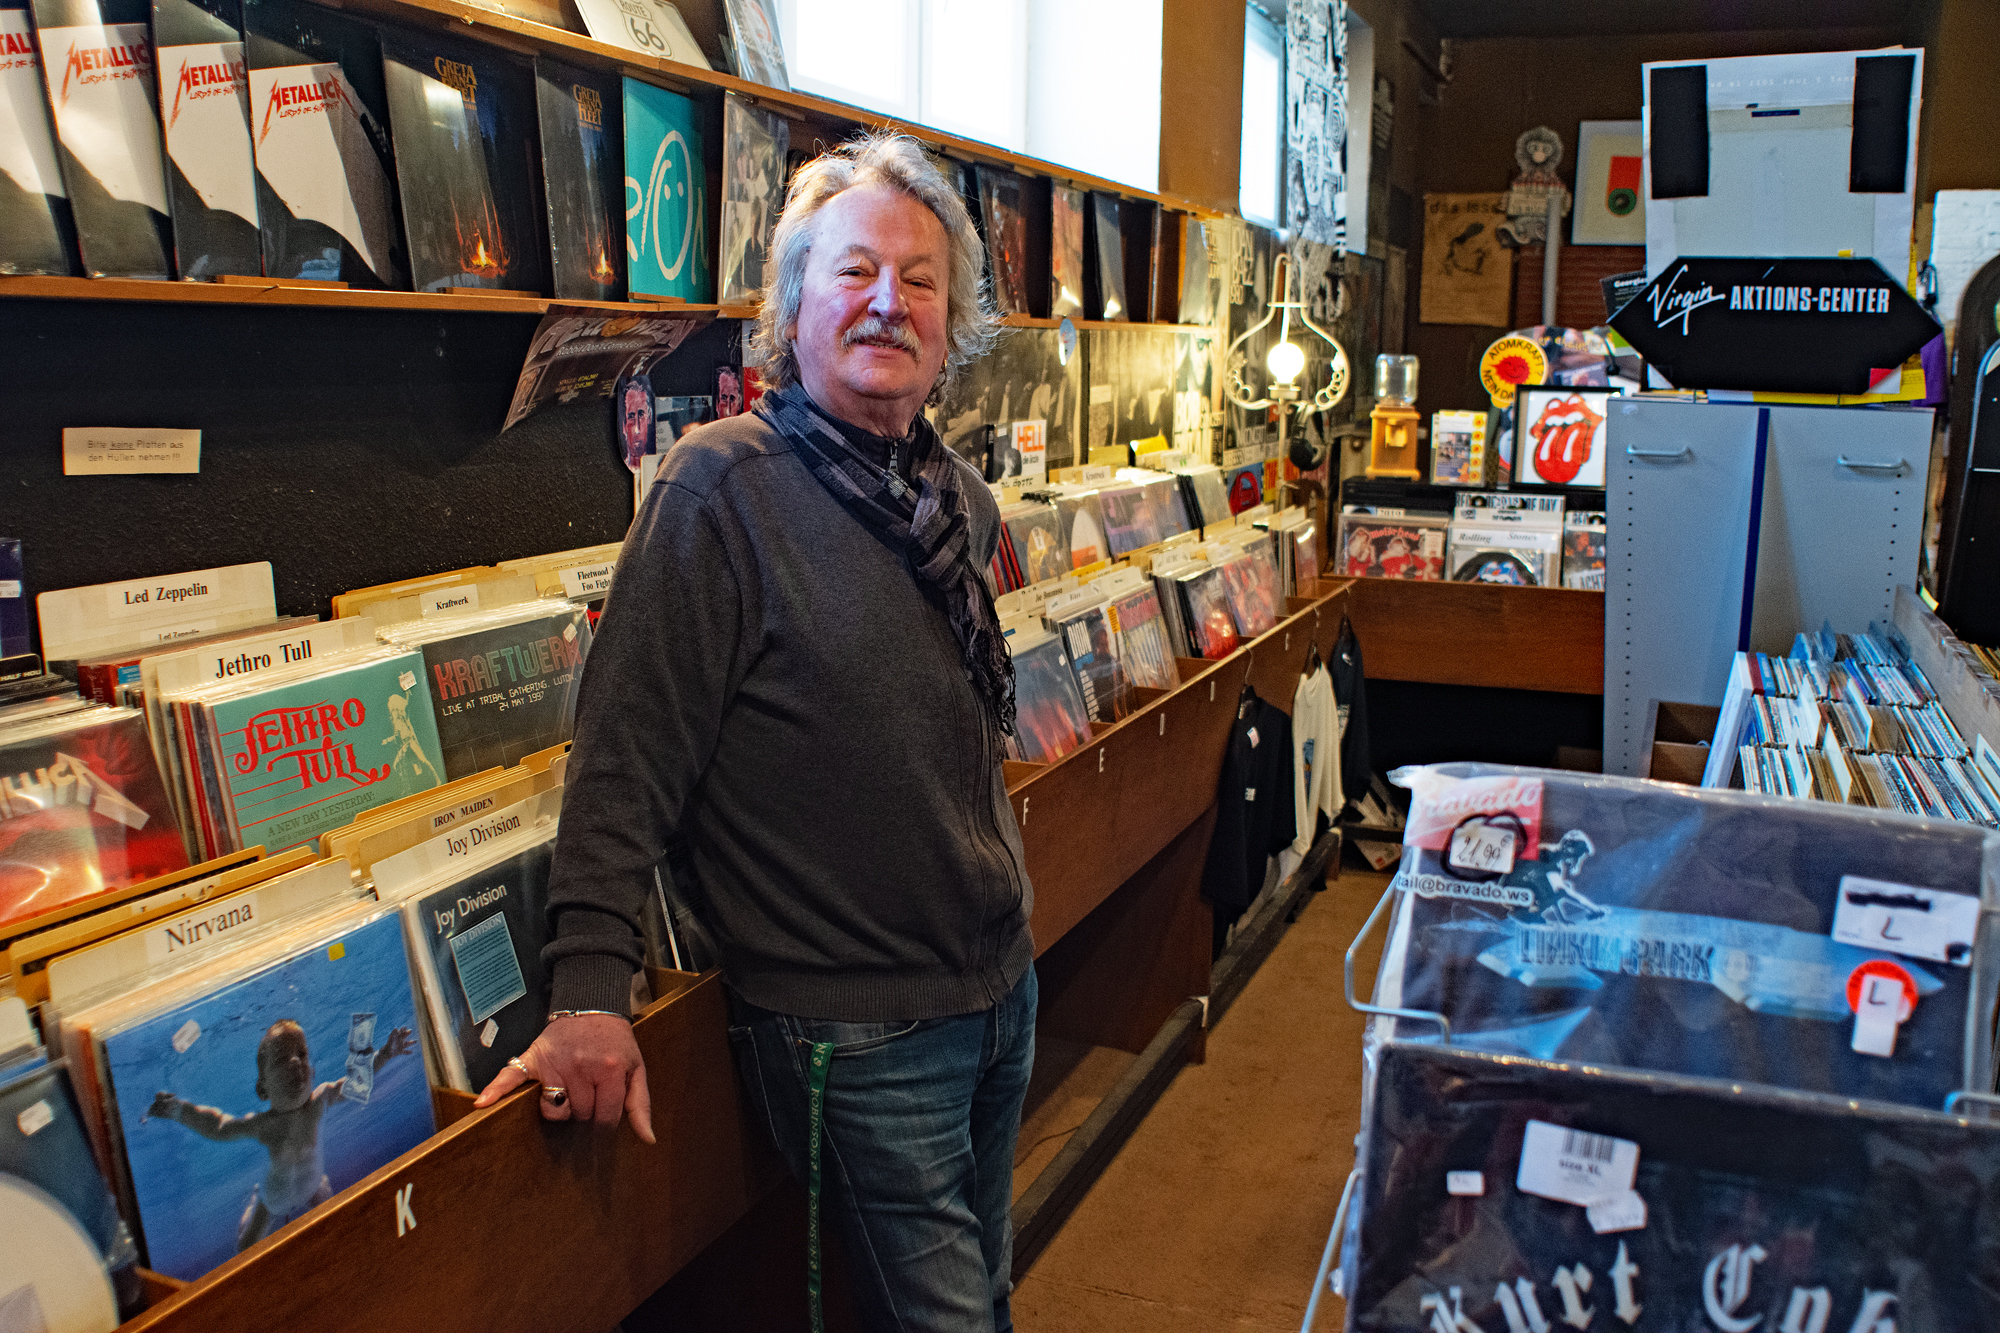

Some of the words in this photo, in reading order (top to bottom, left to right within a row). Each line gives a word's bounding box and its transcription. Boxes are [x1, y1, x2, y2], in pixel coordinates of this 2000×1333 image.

[631, 17, 665, 51] 66
[434, 57, 478, 85] GRETA
[257, 71, 358, 146] METALLICA
[573, 84, 603, 109] GRETA
[280, 106, 302, 118] LORDS
[578, 102, 603, 126] FLEET
[1647, 264, 1726, 335] Virgin
[1728, 286, 1890, 313] AKTIONS-CENTER
[88, 440, 106, 449] Bitte
[111, 440, 134, 449] keine
[137, 440, 167, 449] Platten
[1459, 533, 1492, 543] Rolling
[1507, 531, 1538, 541] Stones
[577, 567, 609, 580] Fleetwood
[581, 582, 593, 591] Foo
[124, 589, 150, 605] Led
[156, 583, 208, 602] Zeppelin
[436, 596, 469, 611] Kraftwerk
[215, 653, 271, 679] Jethro
[279, 640, 313, 663] Tull
[434, 634, 582, 700] KRAFTWERK
[442, 703, 462, 717] LIVE
[466, 699, 475, 709] AT
[479, 693, 506, 705] TRIBAL
[499, 702, 509, 711] 24
[512, 697, 525, 707] MAY
[528, 691, 544, 703] 1997
[233, 698, 366, 775] JETHRO
[267, 736, 391, 790] TULL
[268, 826, 275, 837] A
[276, 816, 301, 834] NEW
[303, 810, 320, 825] DAY
[434, 811, 455, 828] IRON
[460, 797, 494, 818] MAIDEN
[1023, 797, 1029, 826] F
[446, 838, 468, 857] Joy
[469, 813, 521, 847] Division
[434, 908, 456, 935] Joy
[457, 884, 508, 918] Division
[165, 901, 254, 953] Nirvana
[454, 933, 468, 950] JOY
[468, 916, 503, 941] DIVISION
[1880, 916, 1903, 941] L
[1868, 980, 1886, 1006] L
[395, 1183, 417, 1238] K
